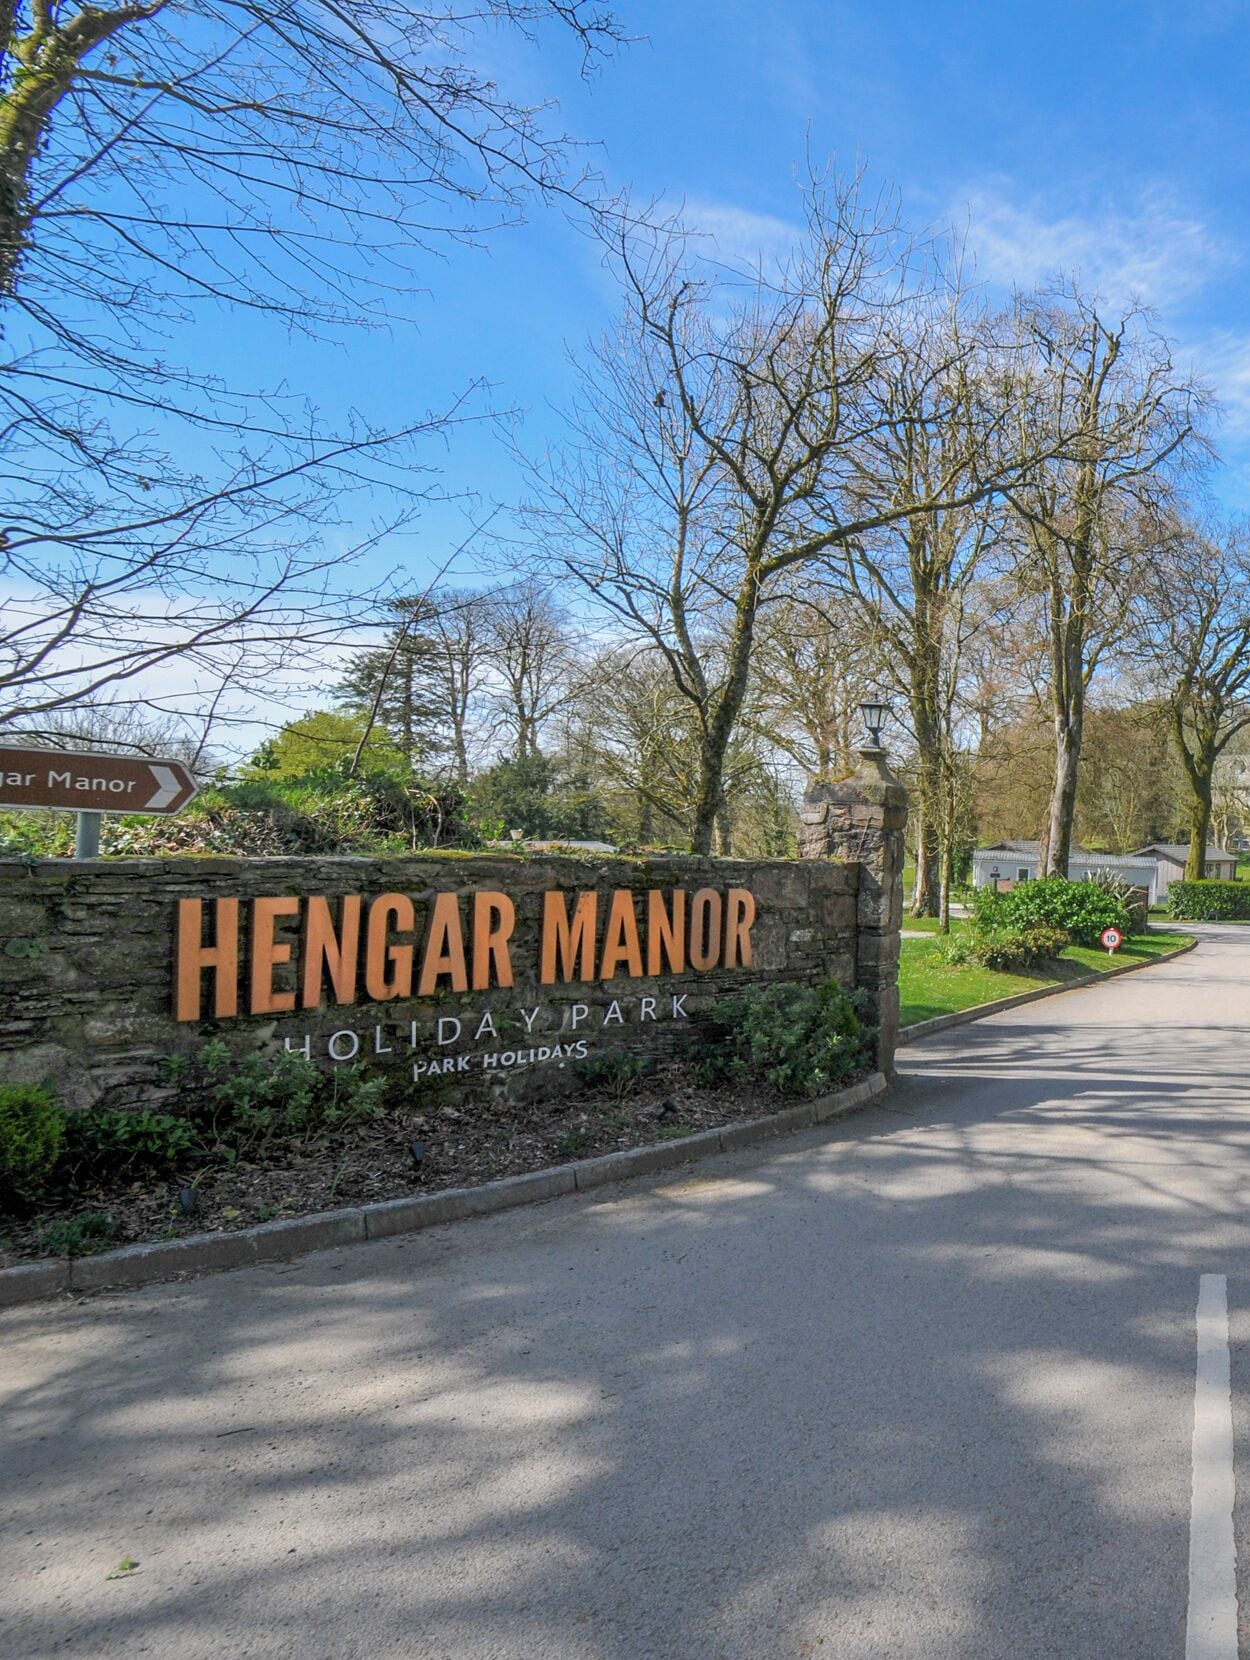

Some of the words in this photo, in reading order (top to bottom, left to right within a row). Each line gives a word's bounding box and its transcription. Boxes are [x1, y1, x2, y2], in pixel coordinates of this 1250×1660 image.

[0, 771, 36, 787] ar
[48, 771, 136, 793] Manor
[177, 891, 516, 1022] HENGAR
[541, 887, 756, 984] MANOR
[1106, 935, 1116, 943] 10
[284, 1008, 540, 1061] HOLIDAY
[571, 994, 688, 1030] PARK
[413, 1054, 470, 1082] PARK
[483, 1040, 588, 1068] HOLIDAYS
